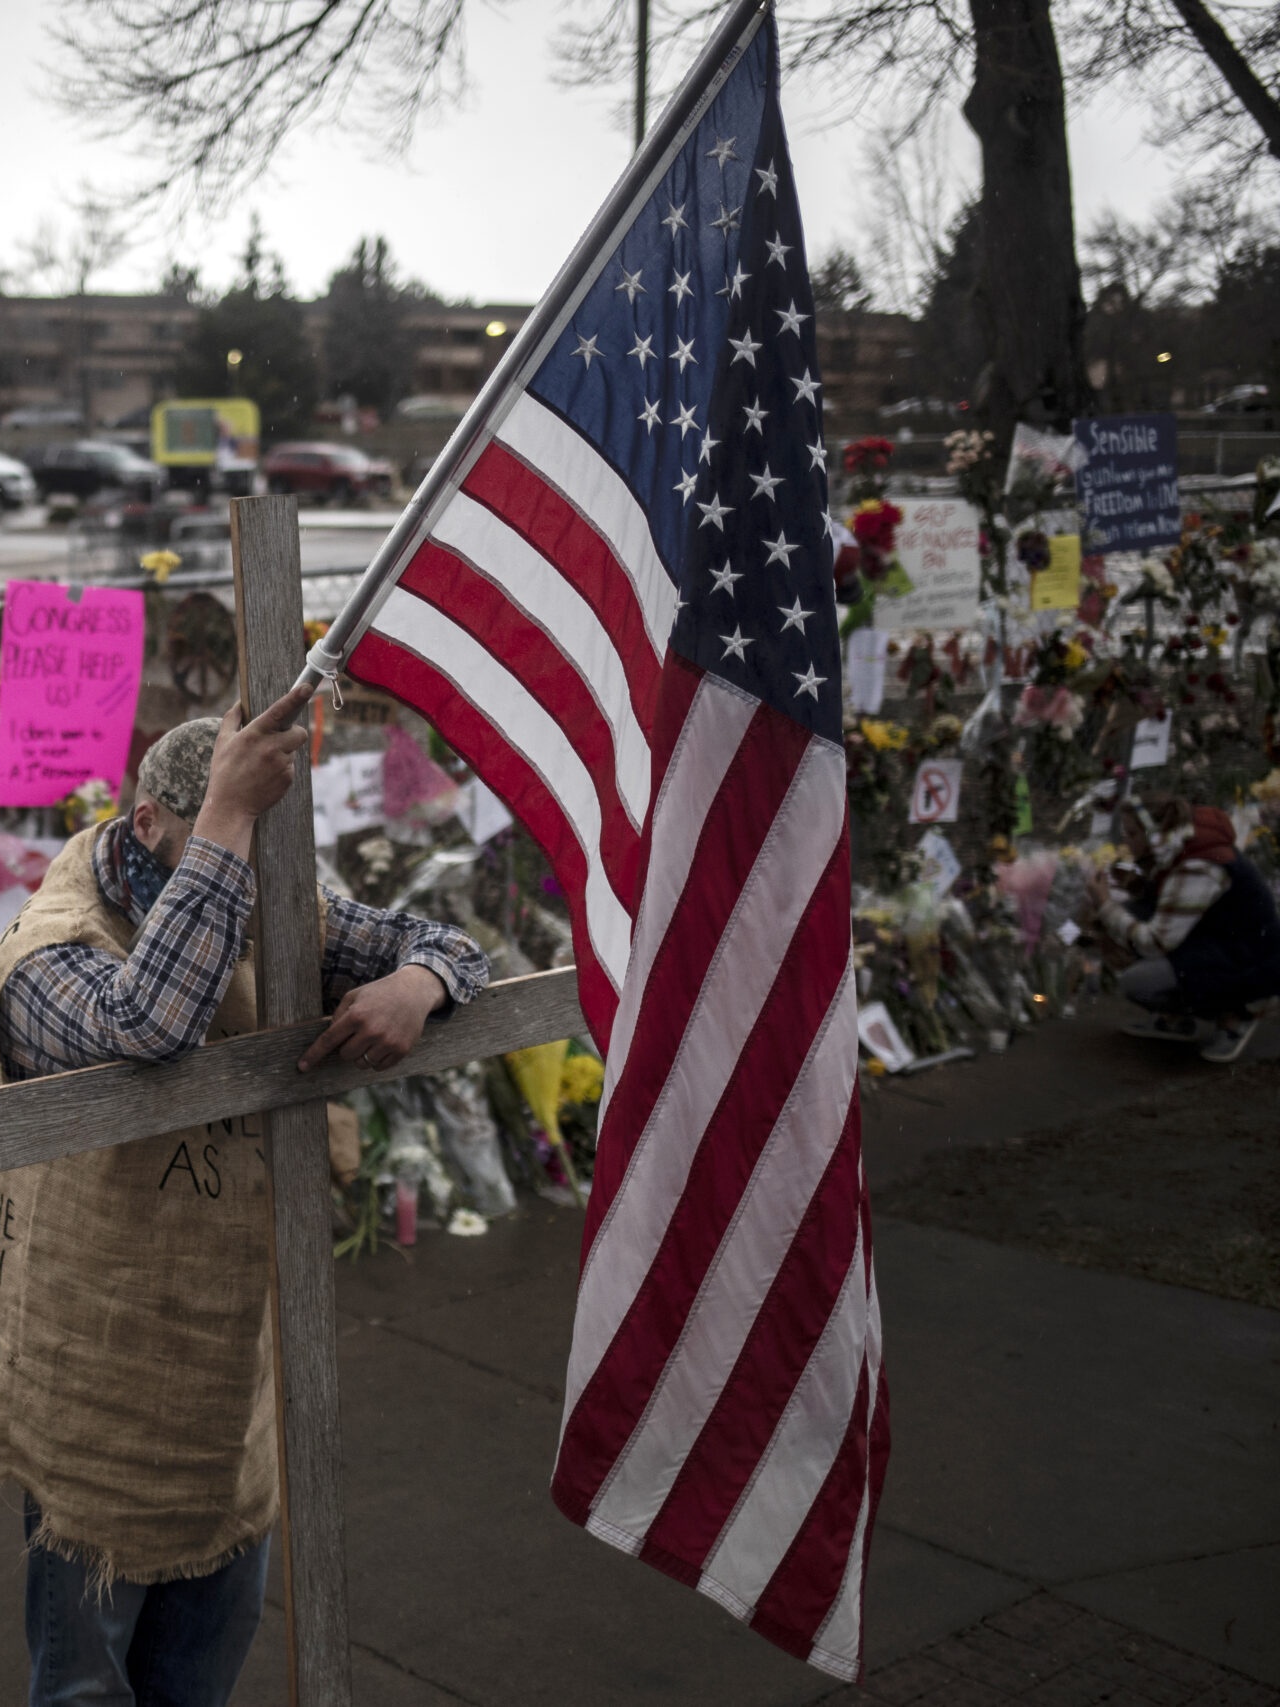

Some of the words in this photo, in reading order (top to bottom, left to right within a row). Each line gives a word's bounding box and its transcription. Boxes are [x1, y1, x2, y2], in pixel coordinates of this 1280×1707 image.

[1089, 421, 1158, 455] Sensible
[8, 584, 131, 637] CONGRESS
[158, 1140, 221, 1199] AS
